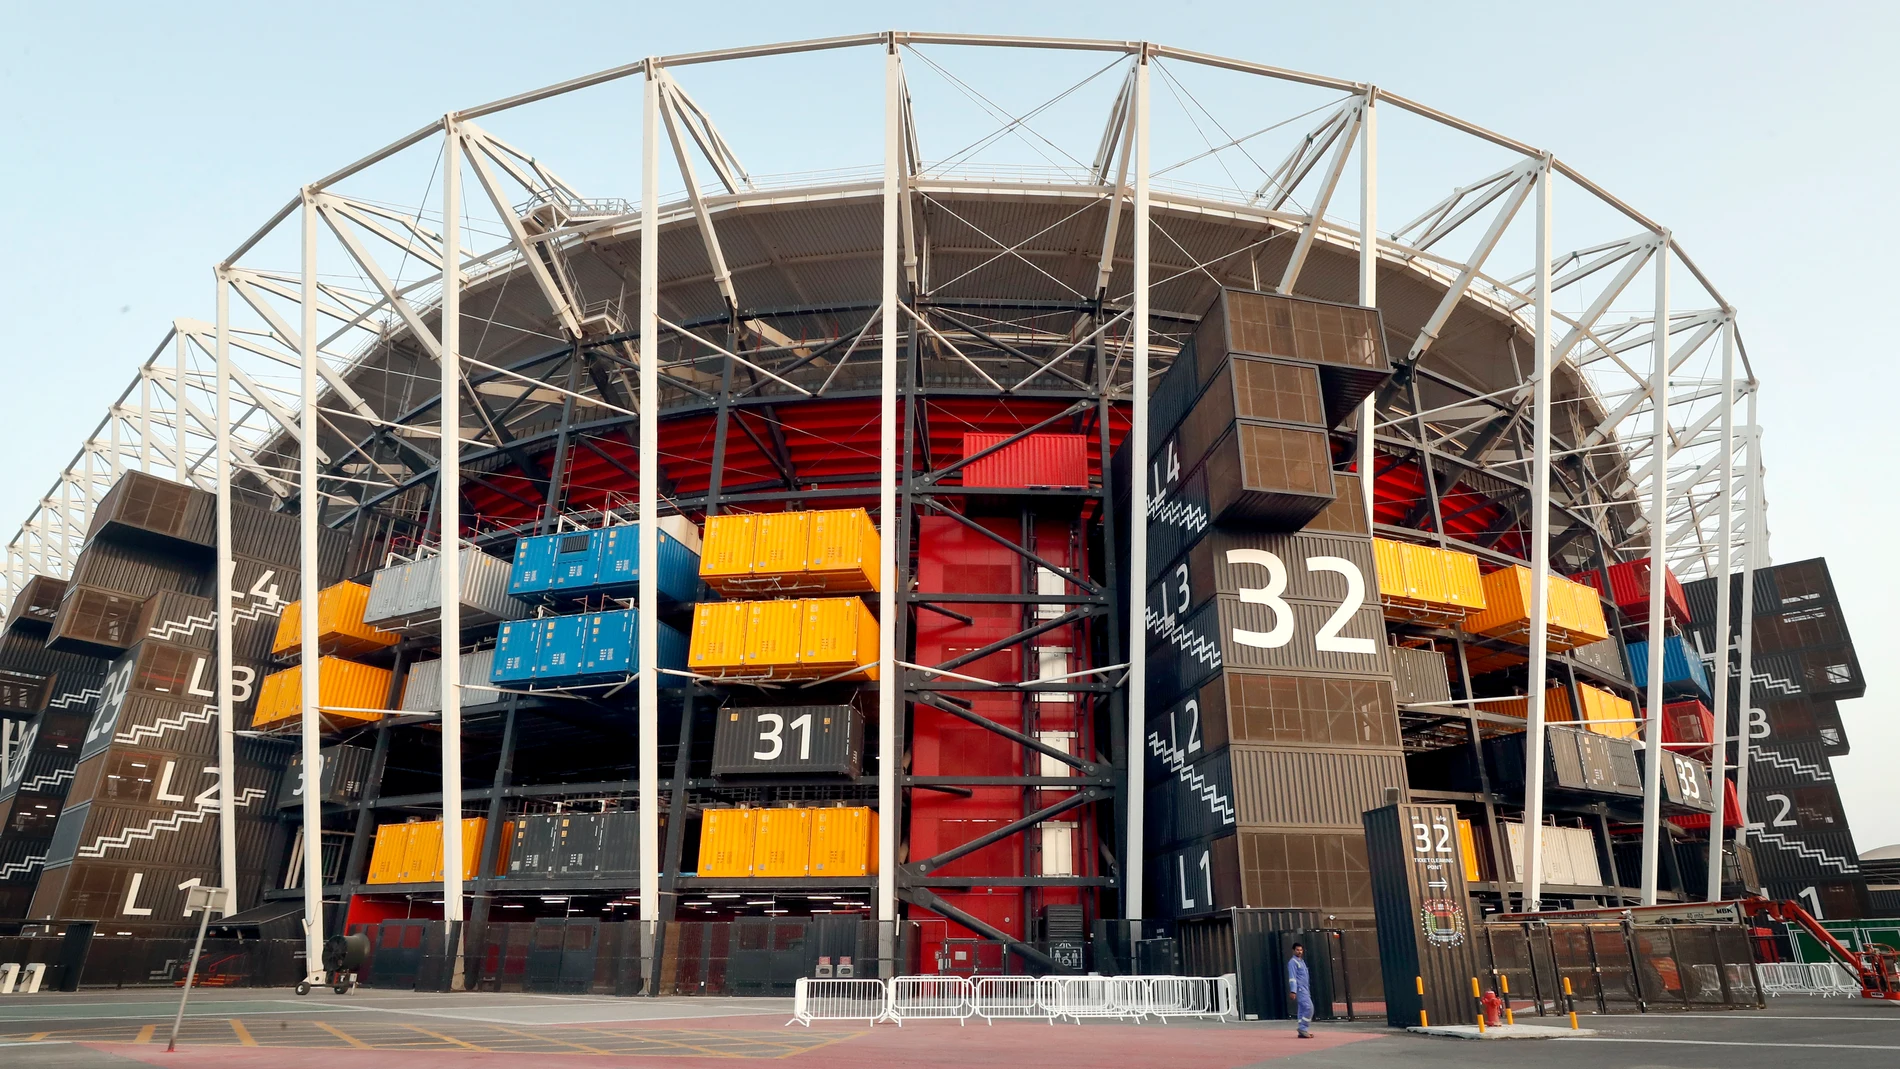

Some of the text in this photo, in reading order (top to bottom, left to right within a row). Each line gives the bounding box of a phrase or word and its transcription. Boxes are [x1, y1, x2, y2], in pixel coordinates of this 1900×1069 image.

[1154, 441, 1181, 504] L4
[1162, 563, 1191, 627] L3
[1226, 549, 1376, 654] 32
[86, 660, 133, 743] 29
[1170, 699, 1201, 763] L2
[4, 723, 39, 788] 28
[753, 713, 812, 760] 31
[156, 761, 221, 806] L2
[1674, 757, 1700, 799] 33
[1412, 823, 1452, 853] 32
[1179, 849, 1213, 909] L1
